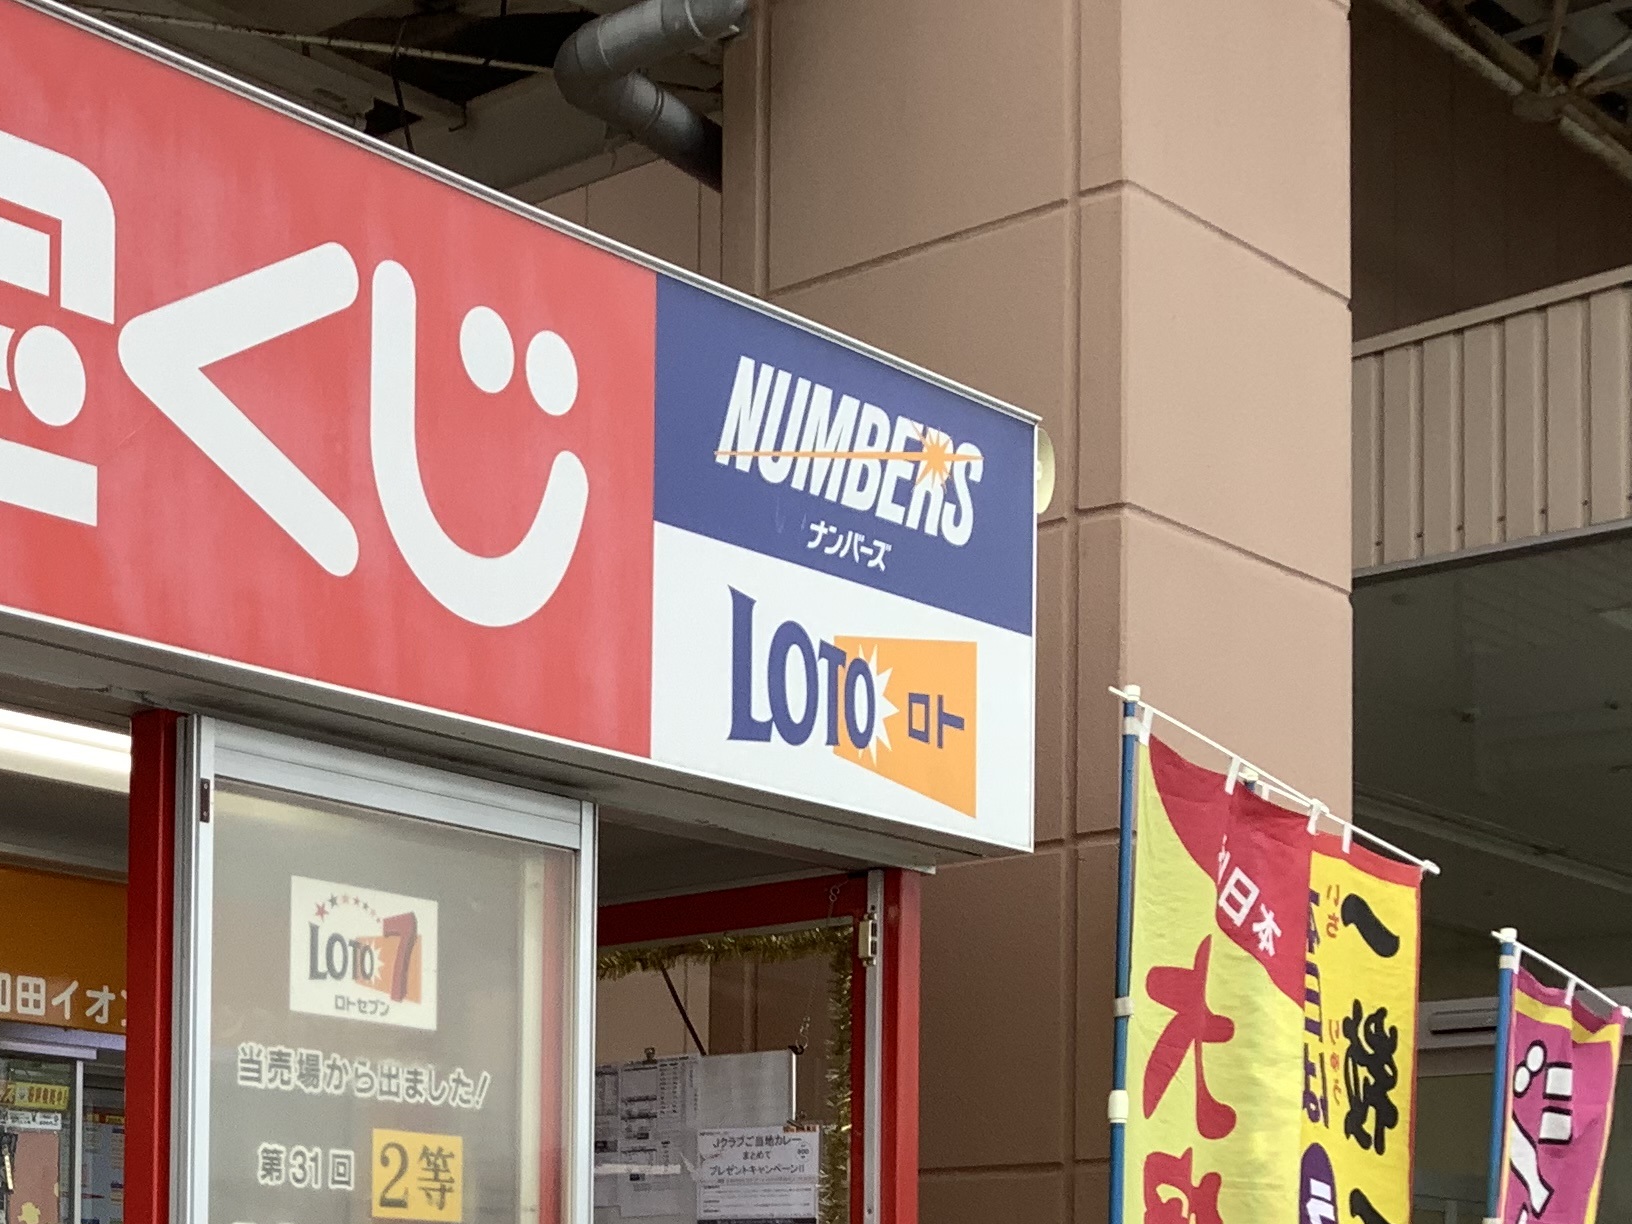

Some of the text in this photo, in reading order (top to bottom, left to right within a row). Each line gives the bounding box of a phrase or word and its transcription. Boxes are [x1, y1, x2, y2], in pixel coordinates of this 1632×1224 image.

[713, 355, 984, 547] NUMBERS
[807, 519, 892, 571] ナンバーズ
[728, 584, 877, 751] LOTO
[908, 691, 966, 750] ロト
[334, 994, 390, 1018] ロトセブン
[236, 1043, 490, 1110] 当売場から出ました!
[257, 1140, 457, 1212] 第31回 2等
